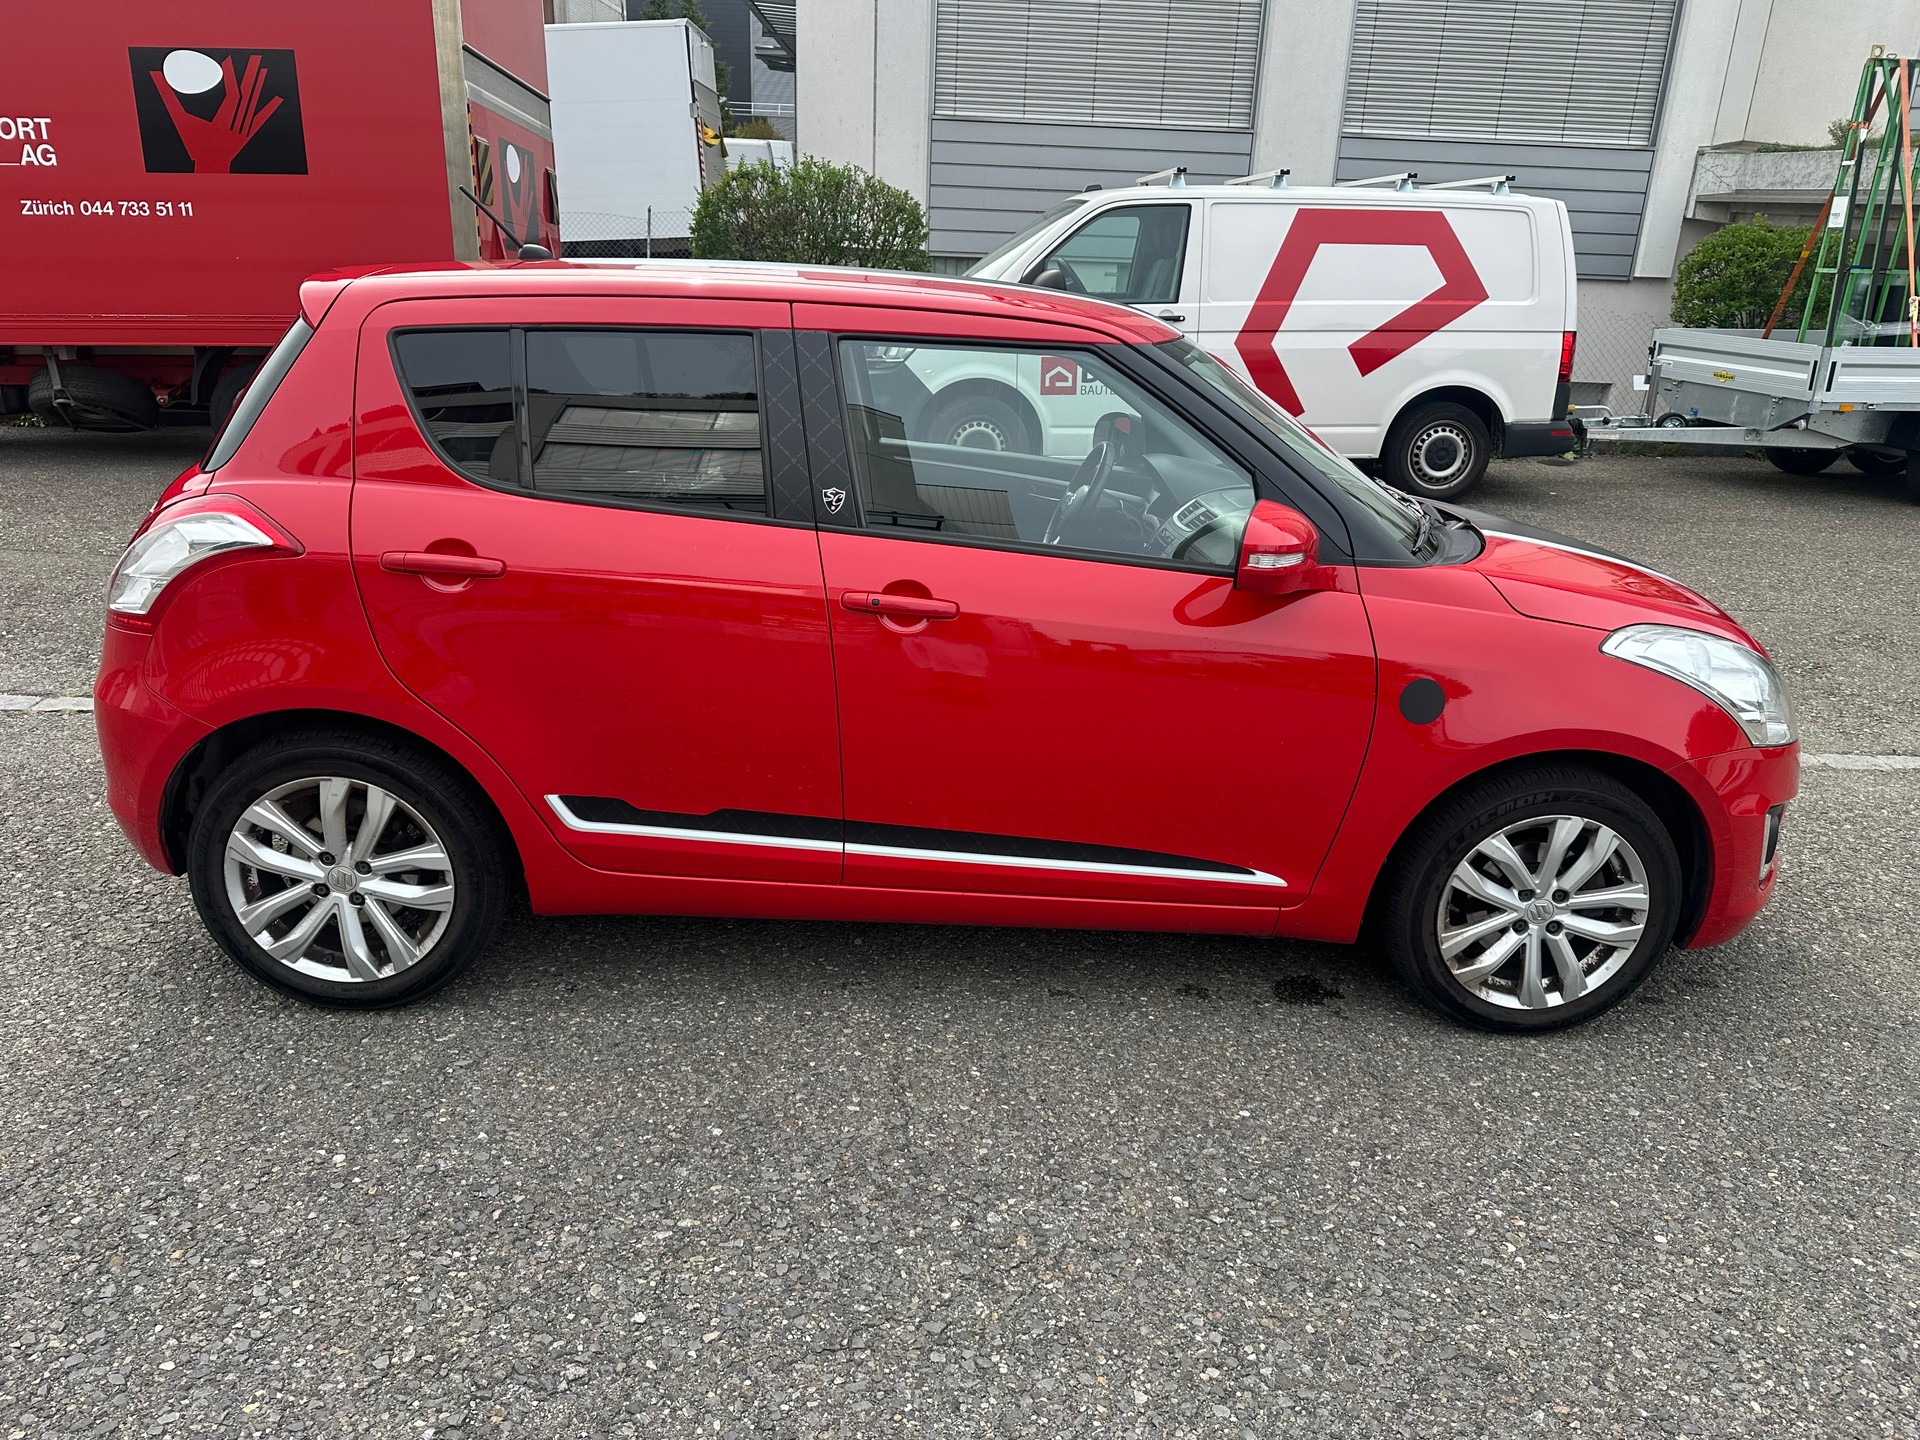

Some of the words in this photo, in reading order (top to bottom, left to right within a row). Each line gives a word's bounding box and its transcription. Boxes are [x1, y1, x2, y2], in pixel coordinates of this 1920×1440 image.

[20, 144, 58, 167] AG
[20, 200, 75, 216] Zürich
[80, 201, 114, 216] 044
[118, 201, 150, 217] 733
[155, 201, 174, 217] 51
[178, 201, 194, 217] 11
